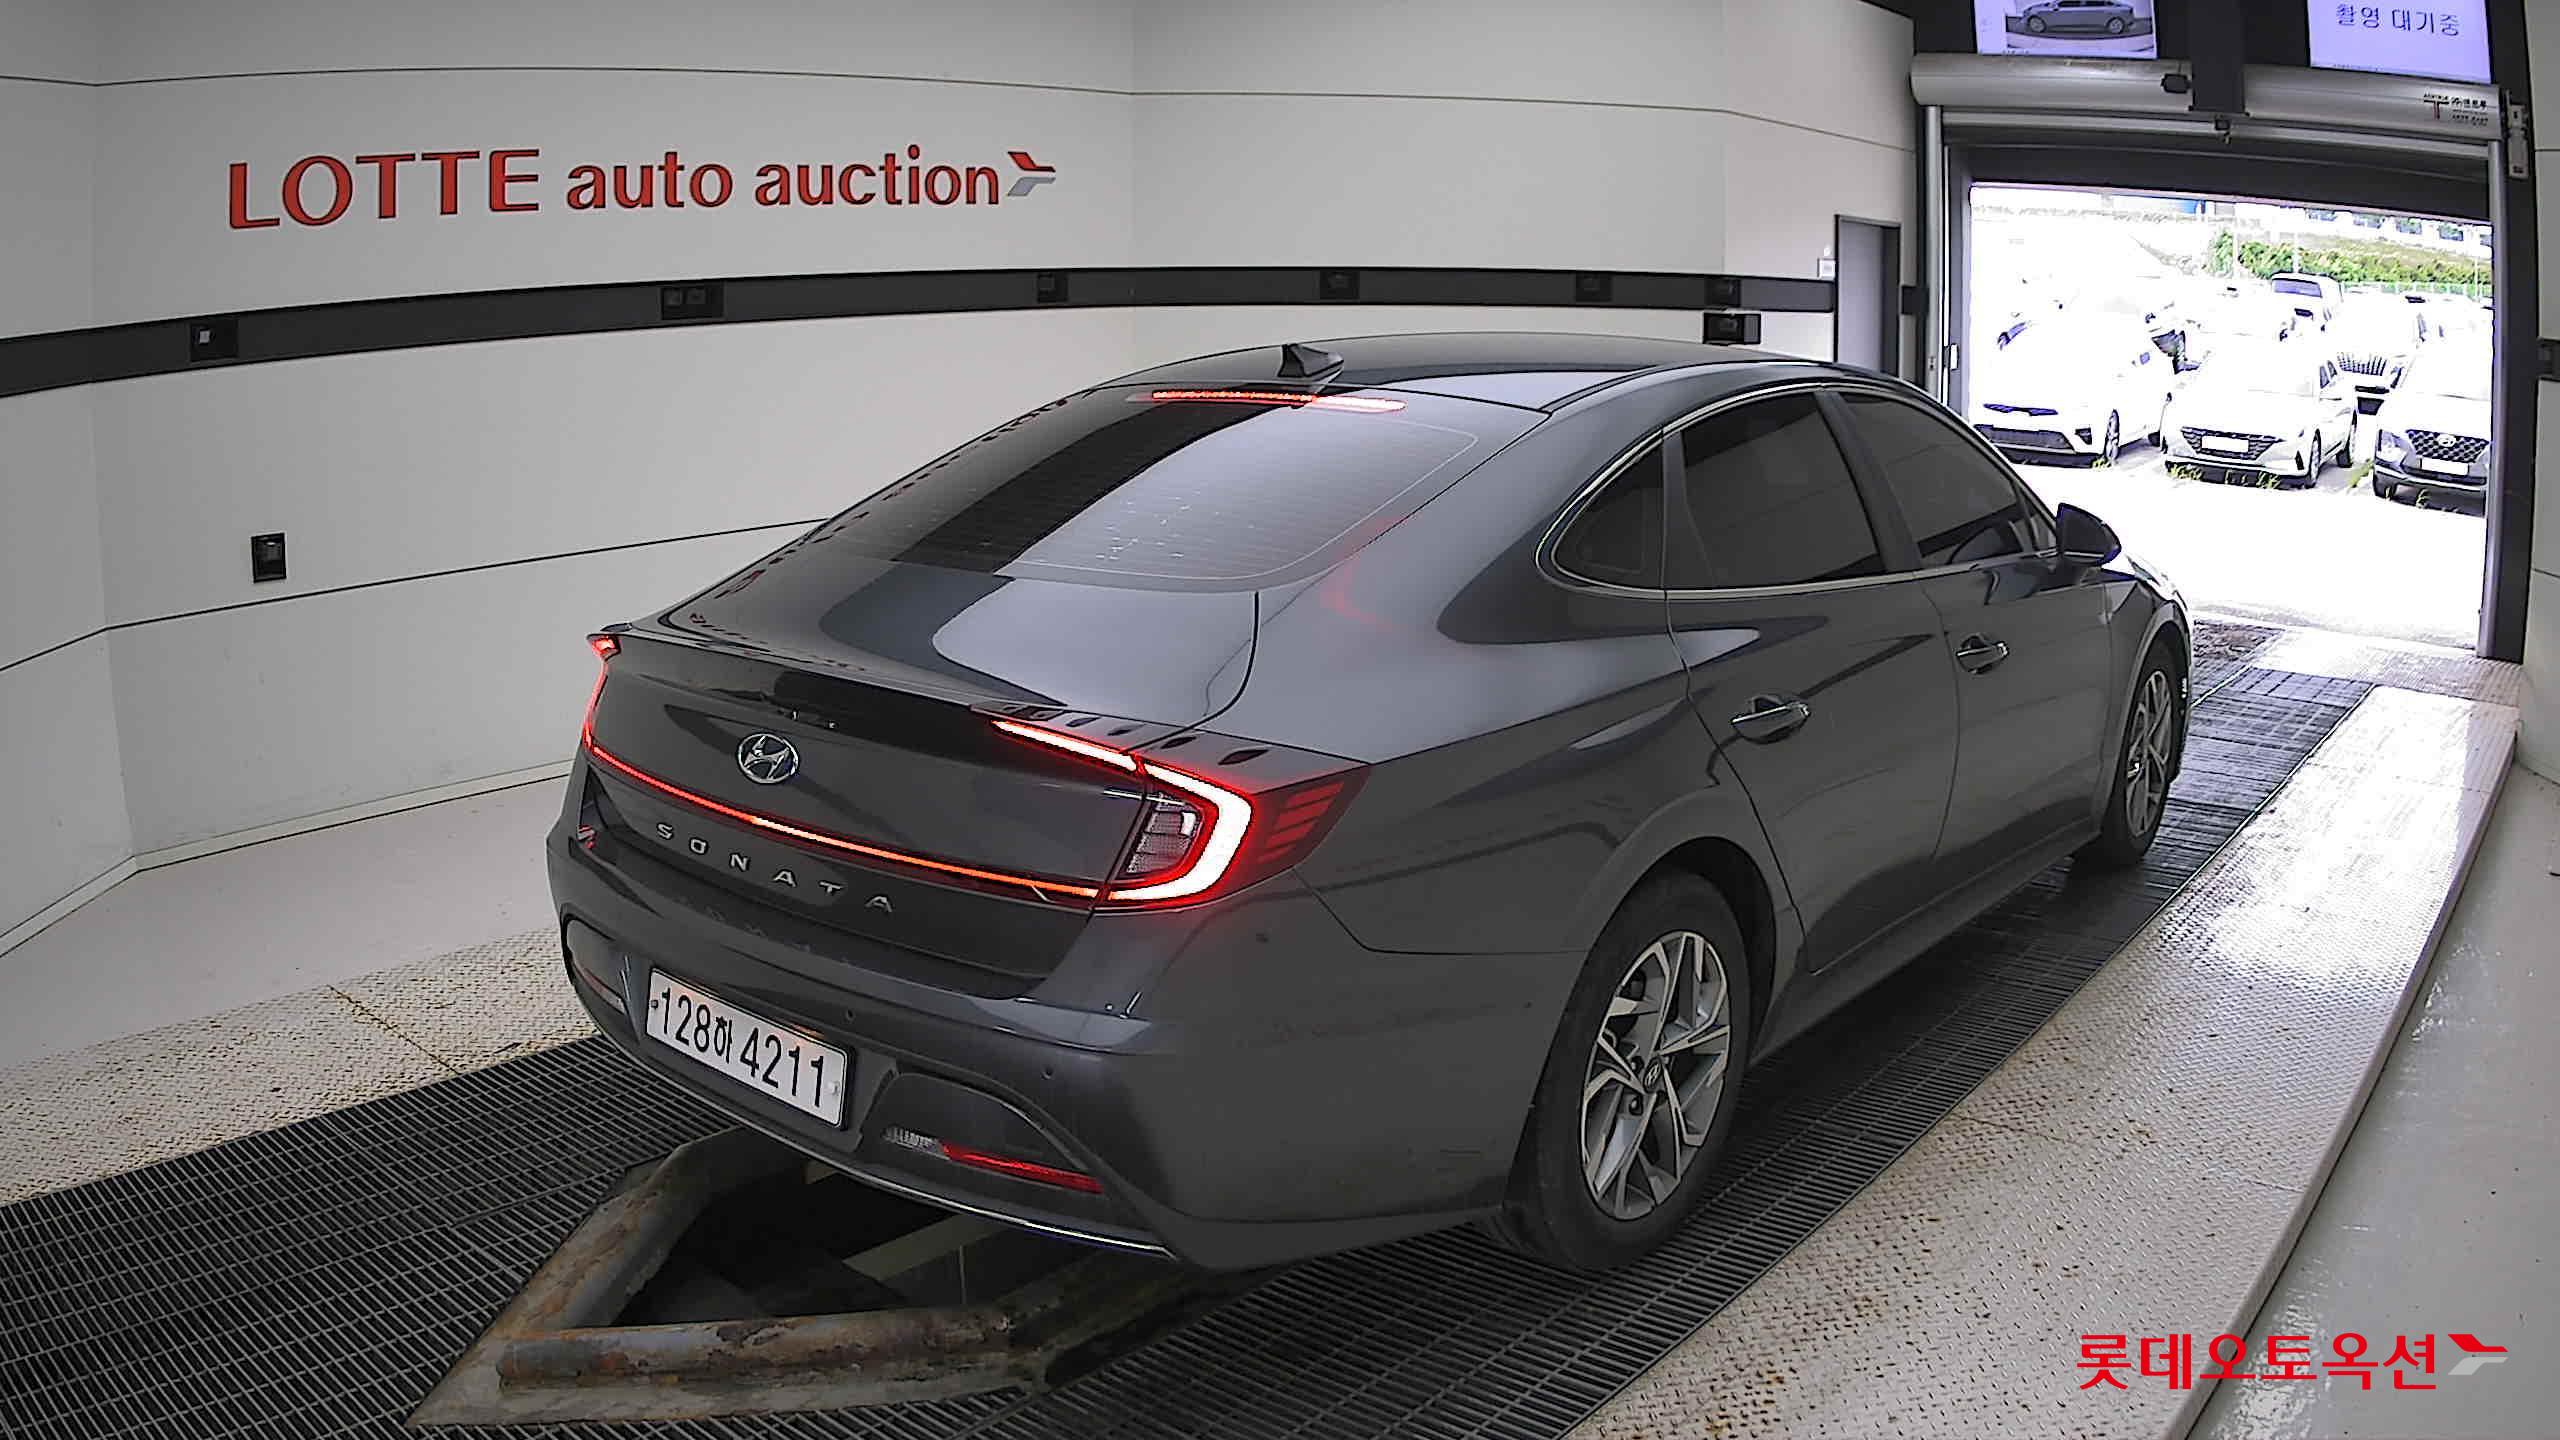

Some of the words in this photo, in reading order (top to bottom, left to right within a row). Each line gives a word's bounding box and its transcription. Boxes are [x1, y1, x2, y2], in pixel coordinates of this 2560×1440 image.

[2336, 5, 2379, 28] 촬영
[230, 151, 539, 229] LOTTE
[568, 153, 734, 209] auto
[756, 145, 1000, 206] auction
[656, 822, 894, 913] SONATA
